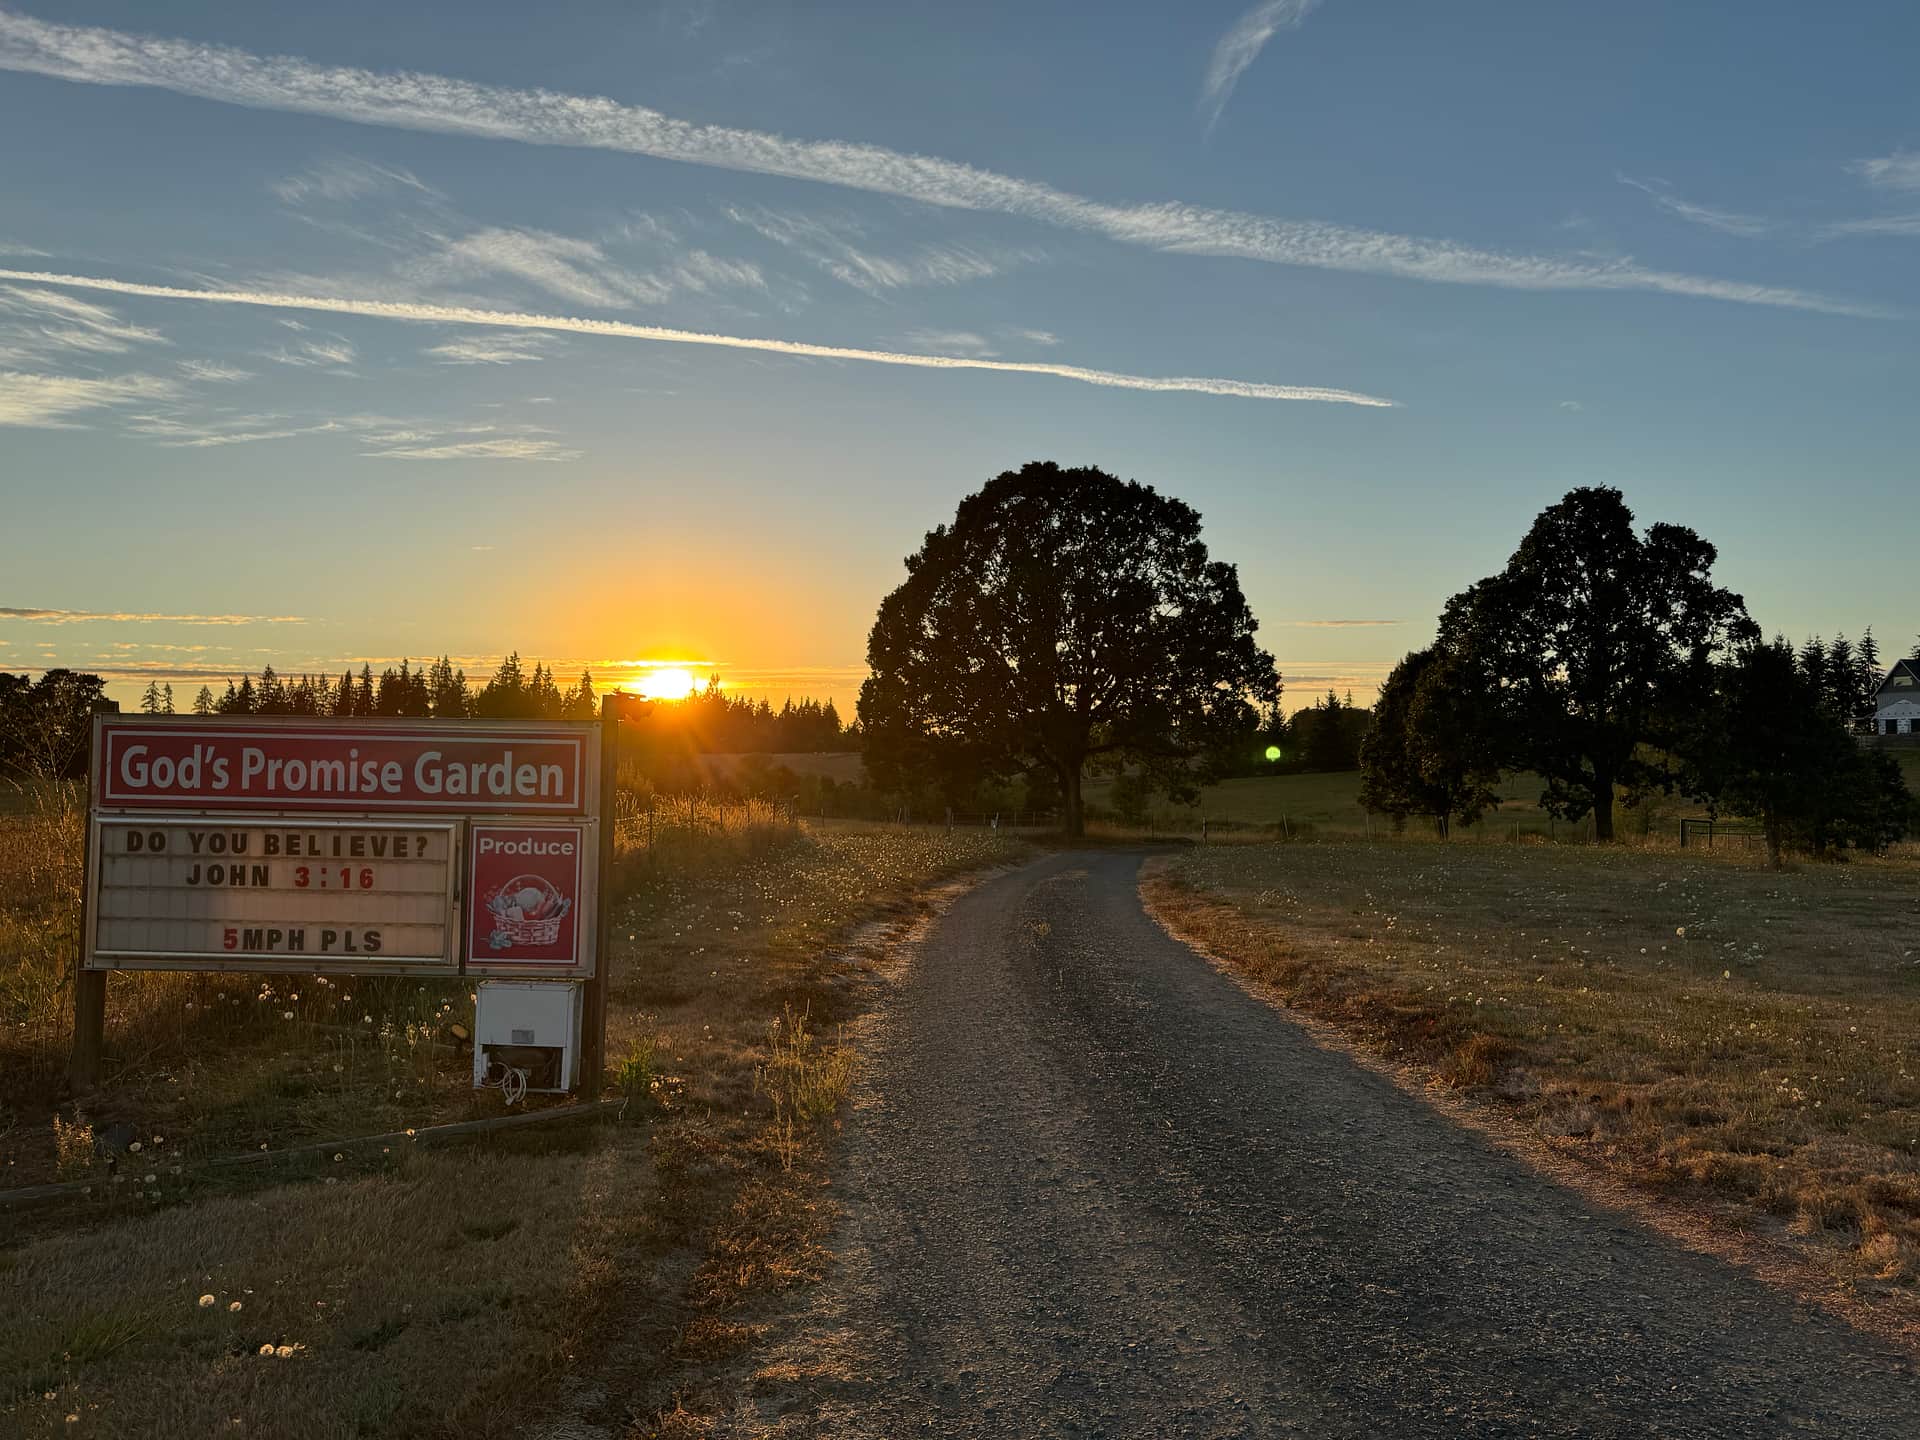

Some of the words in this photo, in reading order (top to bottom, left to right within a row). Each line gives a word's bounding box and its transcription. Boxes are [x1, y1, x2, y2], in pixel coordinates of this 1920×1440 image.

[121, 744, 229, 790] God's
[242, 748, 403, 793] Promise
[414, 751, 564, 797] Garden
[127, 831, 166, 853] DO
[187, 832, 248, 854] YOU
[264, 833, 428, 857] BELIEVE?
[479, 837, 574, 855] Produce
[186, 864, 270, 888] JOHN
[223, 928, 304, 951] 5MPH
[321, 931, 382, 953] PLS
